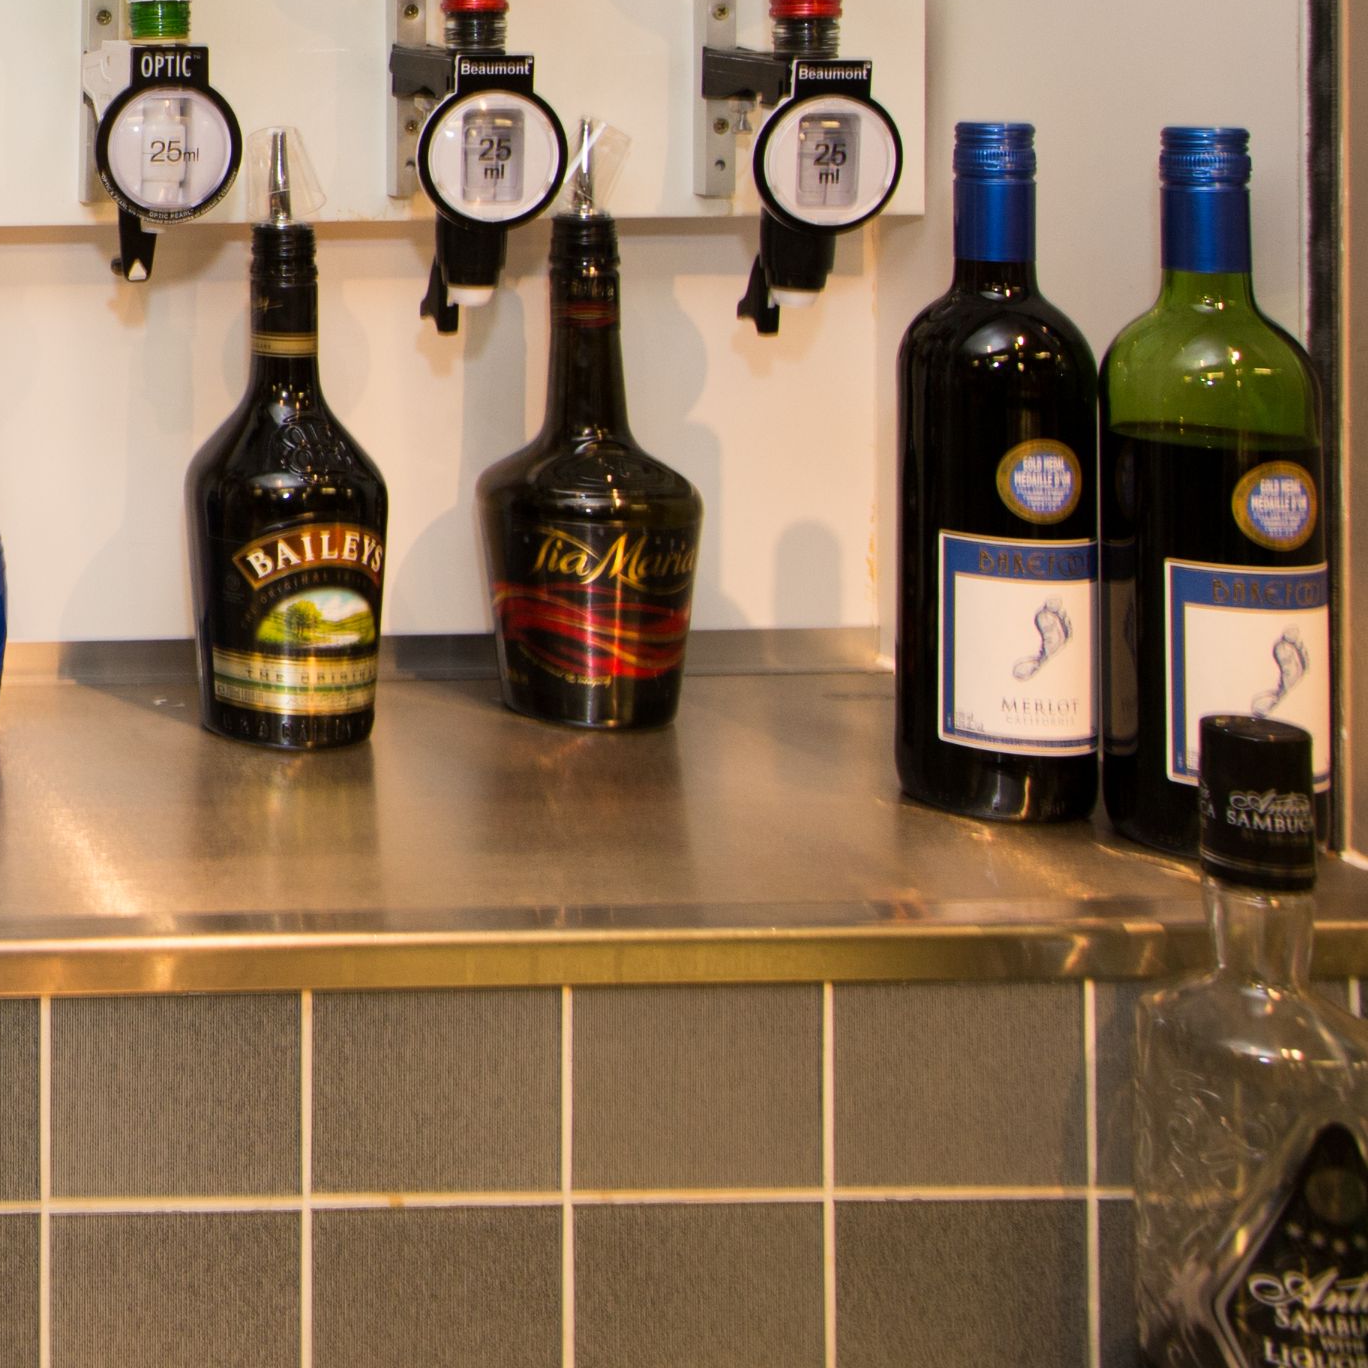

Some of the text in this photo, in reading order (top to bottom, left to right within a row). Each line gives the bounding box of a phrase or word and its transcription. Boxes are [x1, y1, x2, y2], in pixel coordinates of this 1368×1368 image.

[140, 53, 192, 78] OPTIC
[460, 62, 531, 76] Beaumont
[798, 67, 869, 81] Beaumont
[478, 137, 512, 162] 25
[813, 143, 847, 167] 25
[483, 163, 506, 180] ml
[818, 168, 840, 185] ml
[245, 530, 384, 579] BAILEYS
[532, 524, 698, 592] Tia Maria
[1000, 696, 1080, 714] MERLOT
